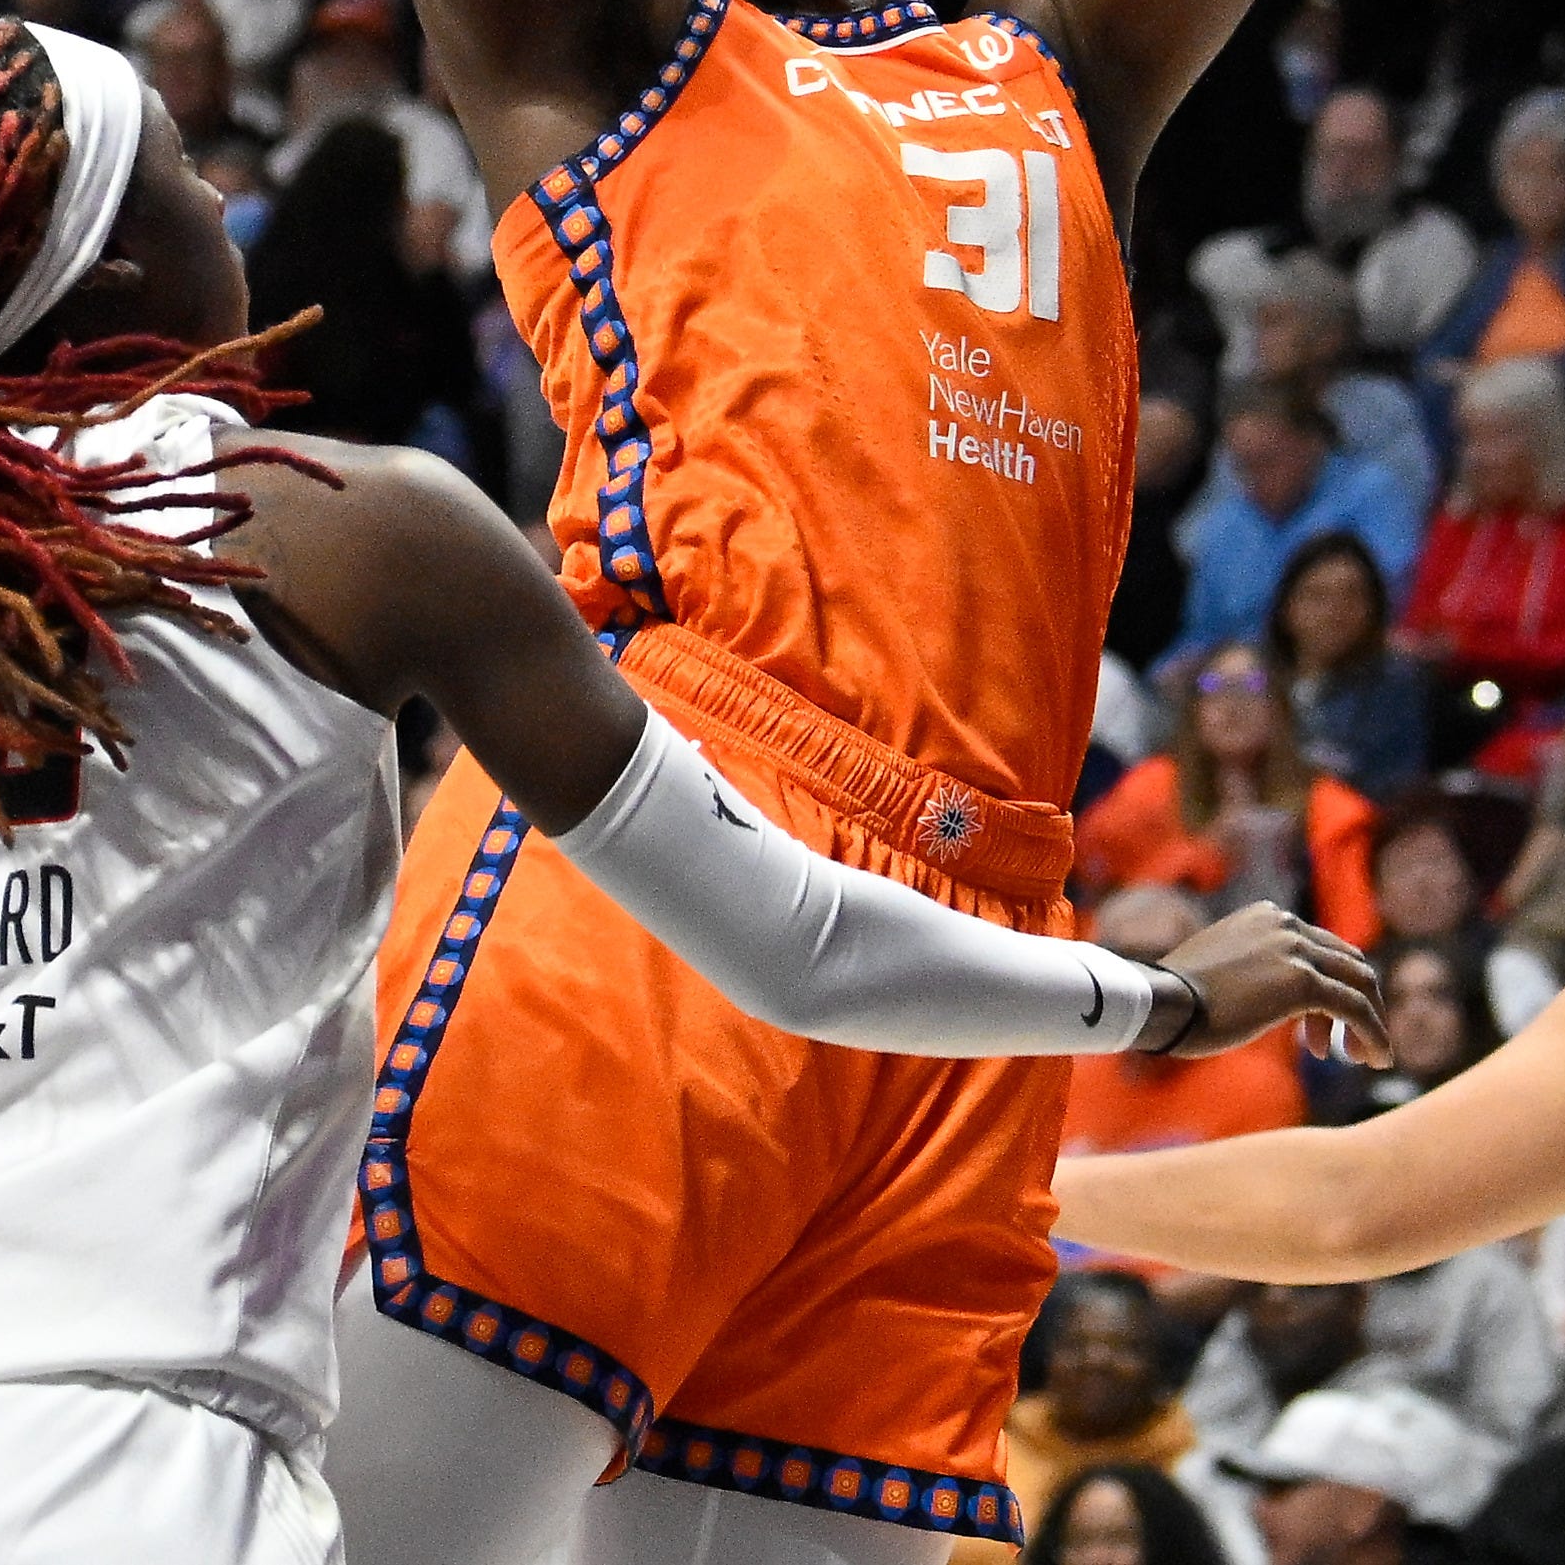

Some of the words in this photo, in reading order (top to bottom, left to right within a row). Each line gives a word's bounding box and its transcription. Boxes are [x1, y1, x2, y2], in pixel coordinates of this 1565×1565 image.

[899, 141, 1060, 323] 31
[918, 329, 992, 379] Yale
[927, 418, 1037, 486] Health
